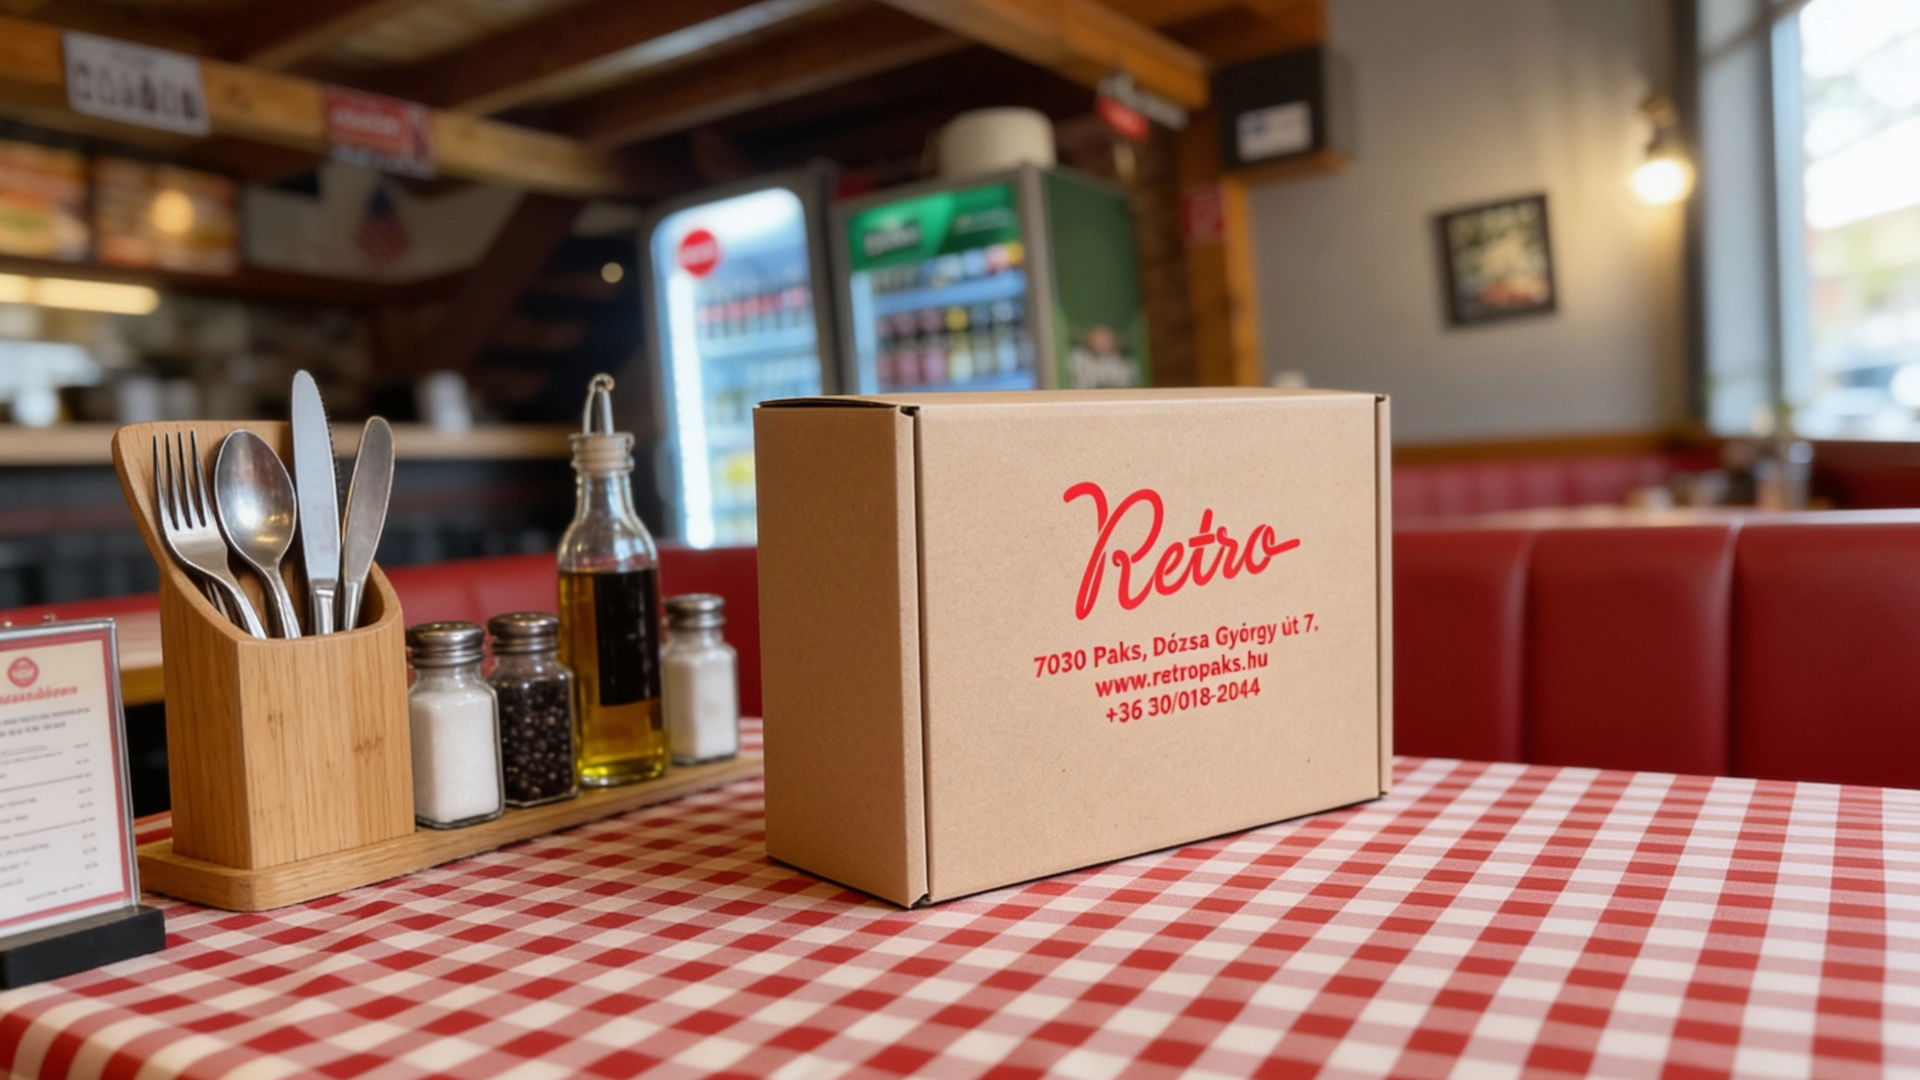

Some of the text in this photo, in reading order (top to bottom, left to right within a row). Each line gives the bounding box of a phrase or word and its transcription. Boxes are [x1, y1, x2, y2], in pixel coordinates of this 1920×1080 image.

[1063, 481, 1301, 621] Retro
[1033, 648, 1087, 679] 7030
[1092, 641, 1148, 669] Paks,
[1152, 632, 1211, 658] Dózsa
[1303, 612, 1320, 632] 7.
[1095, 650, 1269, 699] www.retropaks.hu
[1105, 676, 1261, 724] +36 30/018-2044
